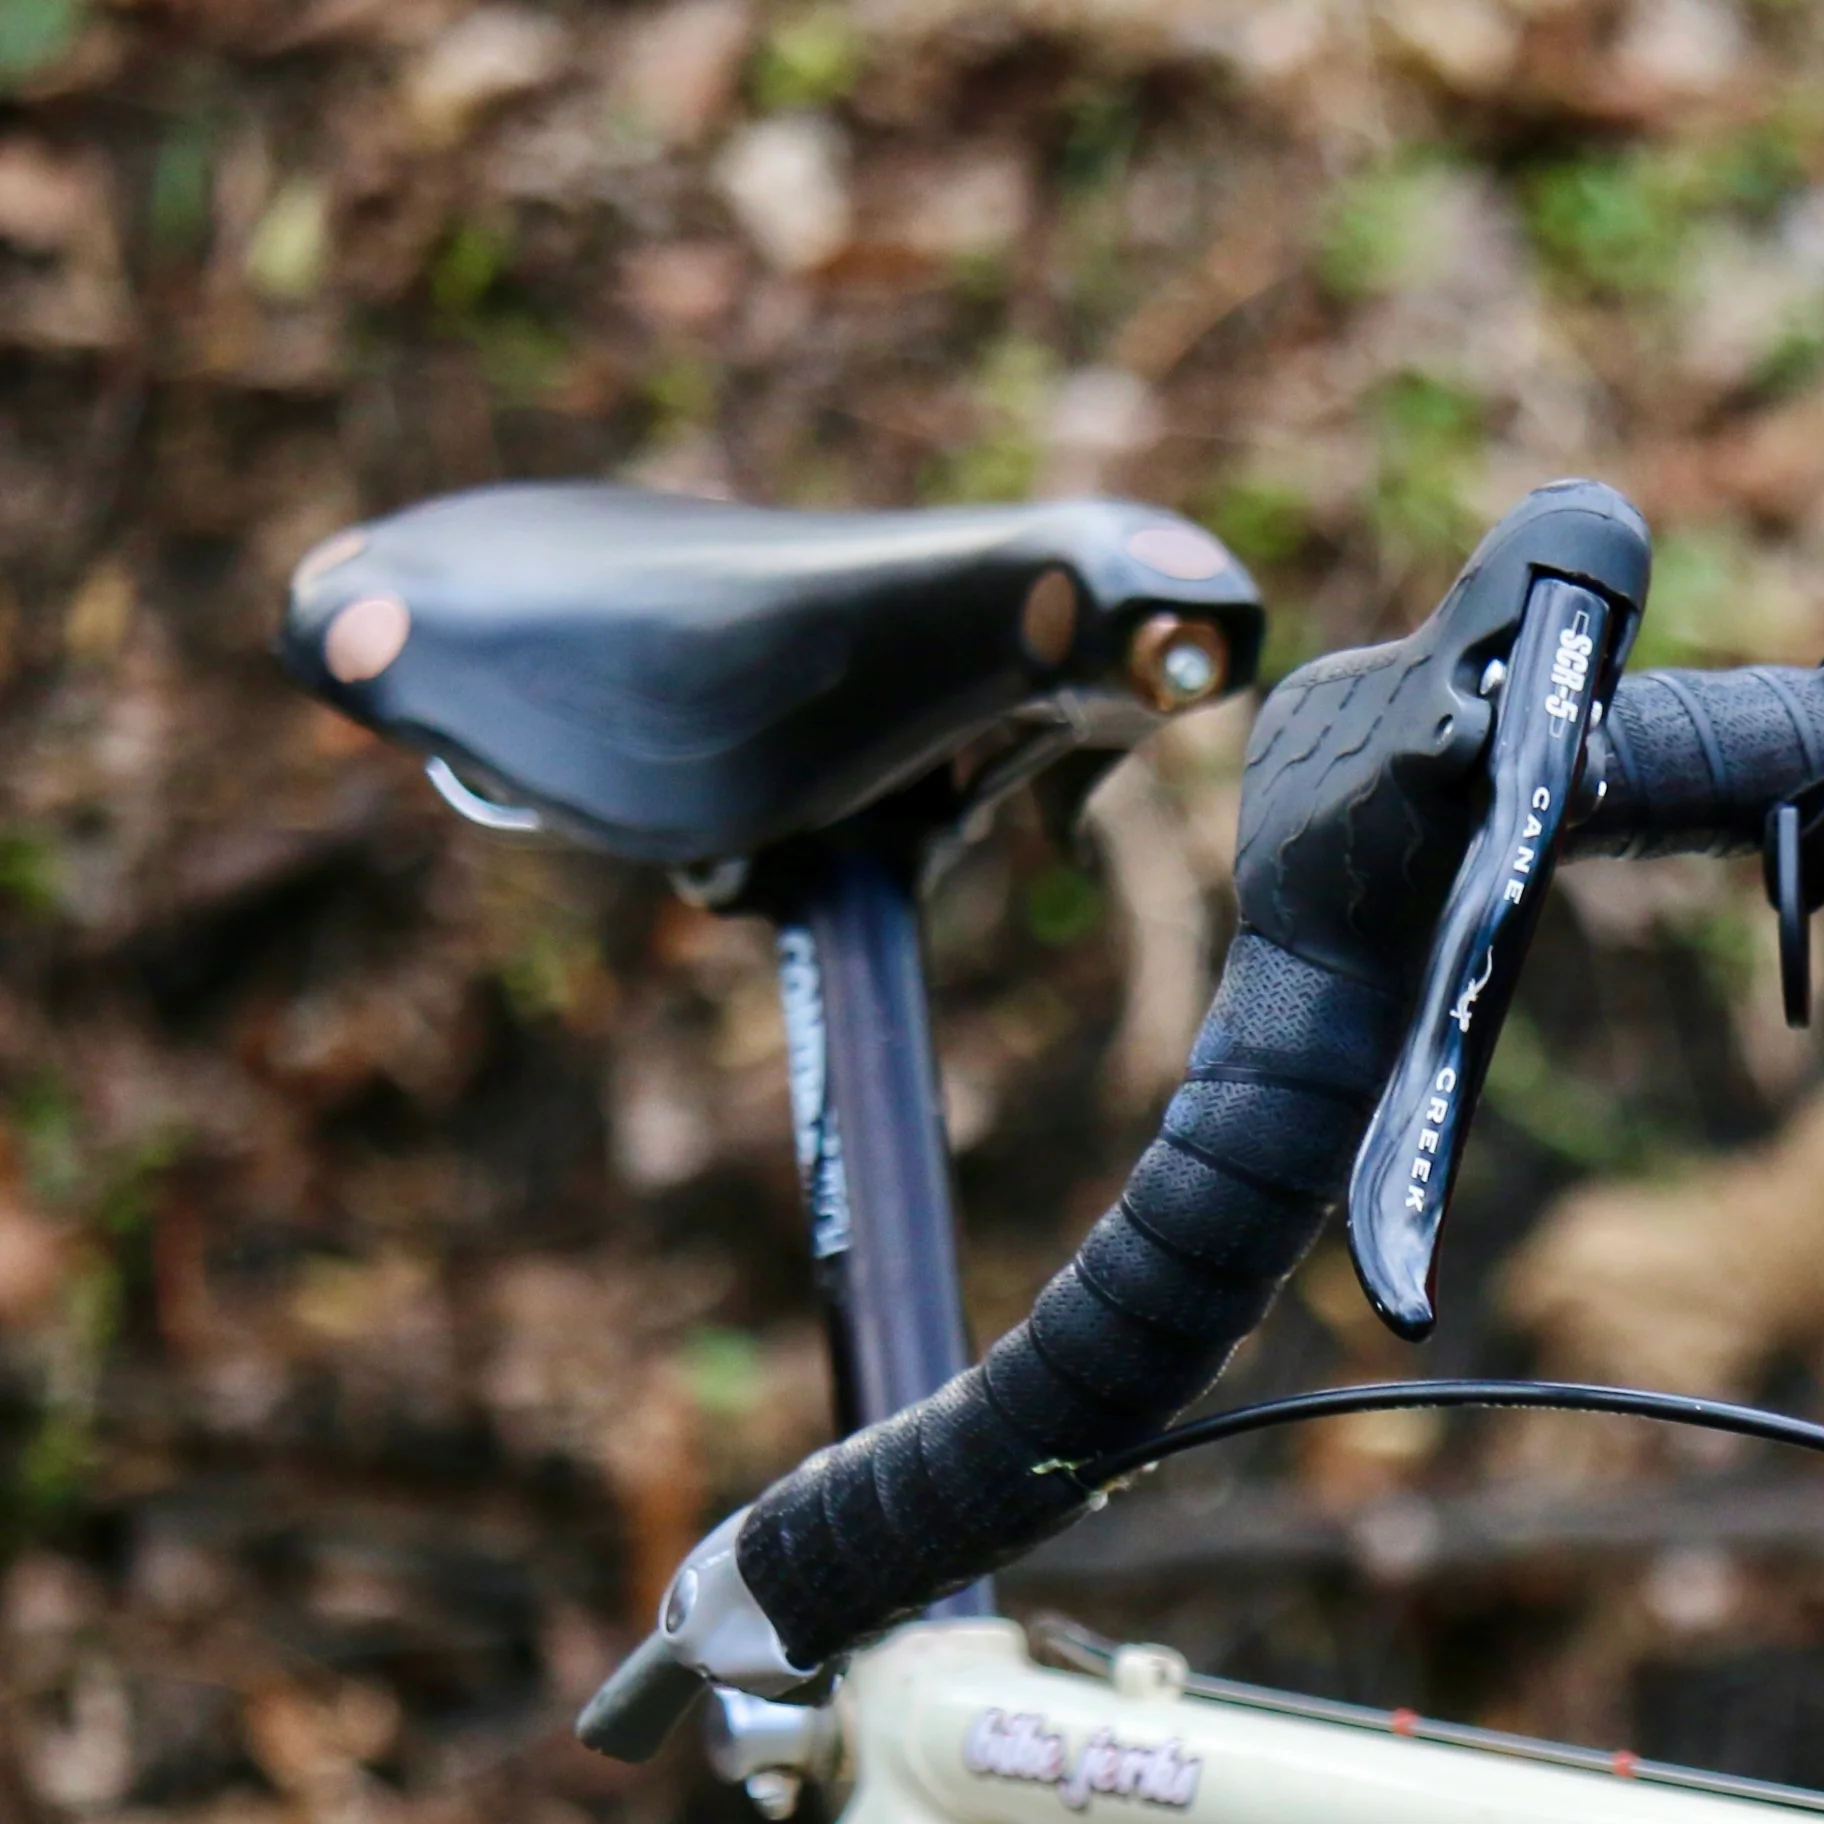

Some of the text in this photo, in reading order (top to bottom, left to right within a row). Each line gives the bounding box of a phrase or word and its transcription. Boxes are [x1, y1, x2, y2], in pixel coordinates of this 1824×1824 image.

[1544, 626, 1594, 724] SCR-5
[1404, 785, 1552, 1214] CANE CREEK
